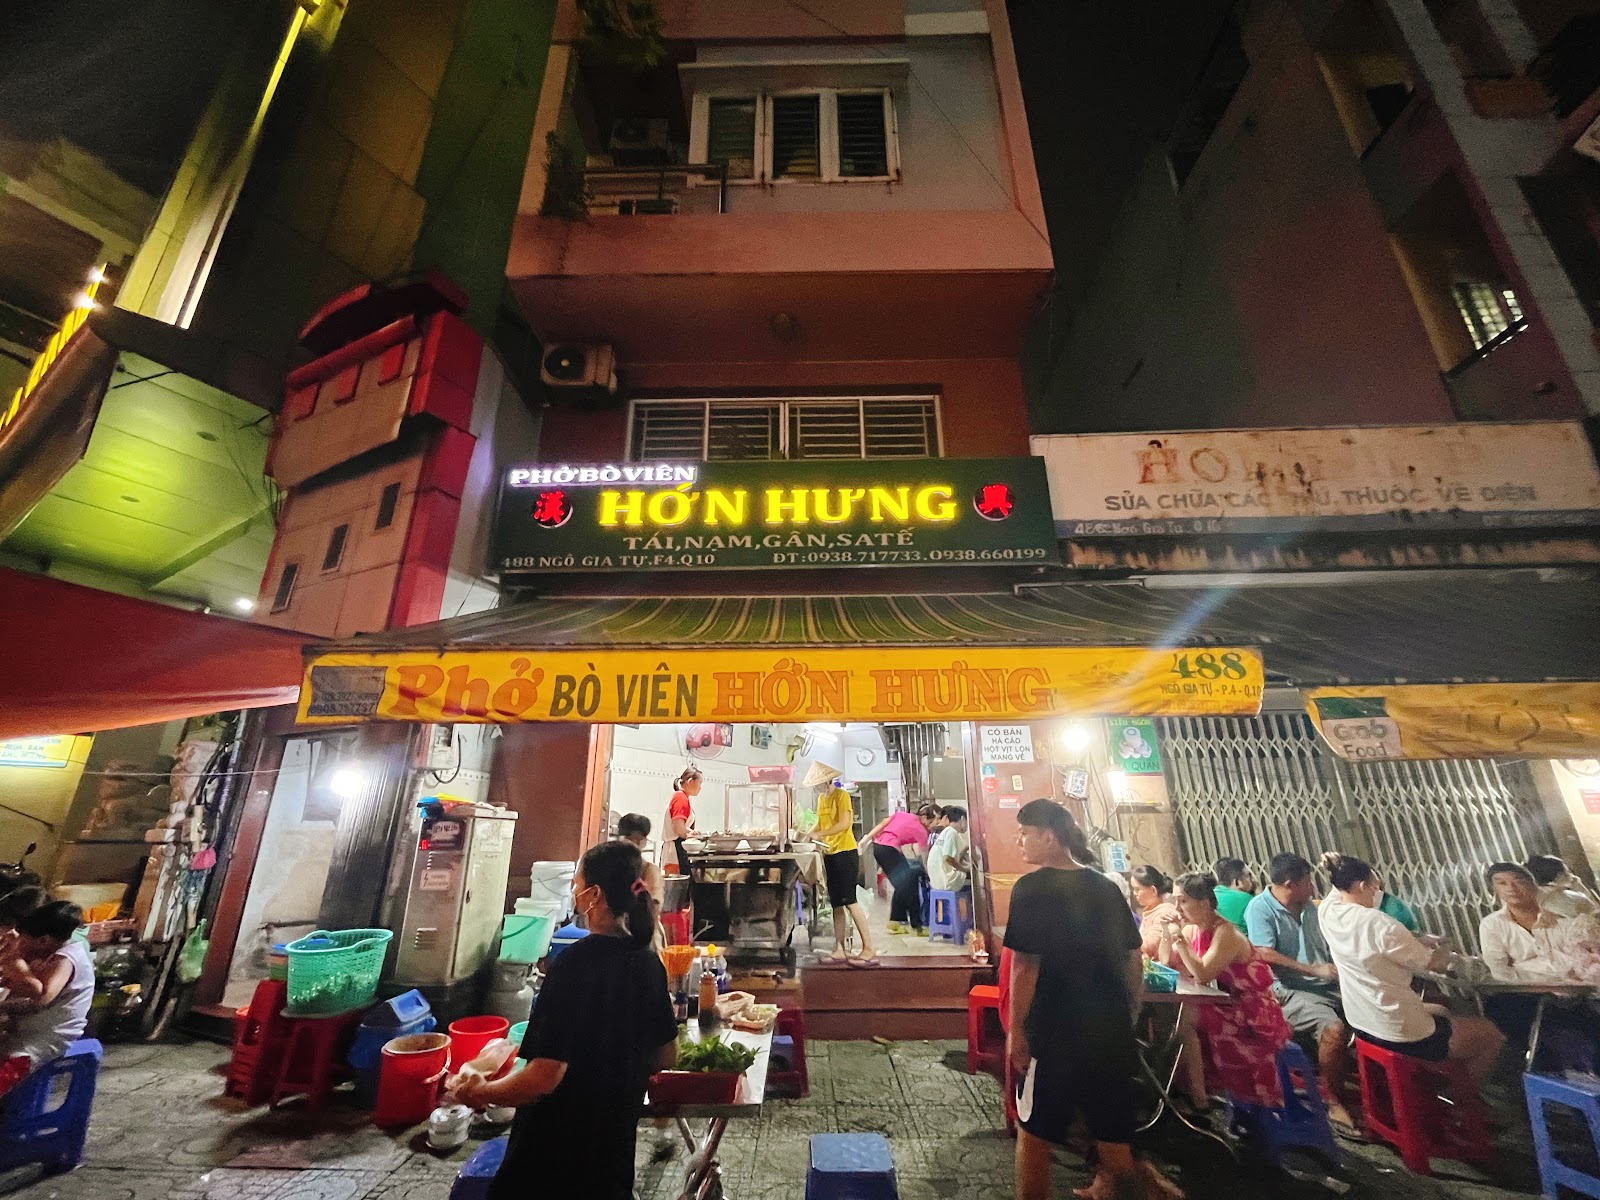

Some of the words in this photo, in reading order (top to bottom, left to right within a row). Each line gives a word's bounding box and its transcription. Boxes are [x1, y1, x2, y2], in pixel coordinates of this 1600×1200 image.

[510, 466, 580, 484] PHỞ
[580, 465, 621, 483] BÒ
[623, 465, 696, 482] VIÊN
[599, 482, 748, 526] HỚN
[765, 486, 957, 524] HƯNG
[1157, 489, 1219, 509] CHỮA
[501, 555, 534, 568] 488
[539, 553, 575, 567] NGÔ
[582, 555, 613, 567] GIA
[1170, 652, 1247, 680] 488
[387, 657, 545, 717] Phở
[550, 663, 601, 717] BÒ
[616, 662, 699, 717] VIÊN
[711, 657, 852, 717] HỚN
[870, 659, 1057, 714] HƯNG
[987, 728, 1000, 736] CÓ
[1003, 728, 1022, 736] BÁN
[1333, 718, 1388, 742] Grab
[1001, 745, 1013, 754] VỊT
[1344, 742, 1388, 759] Food
